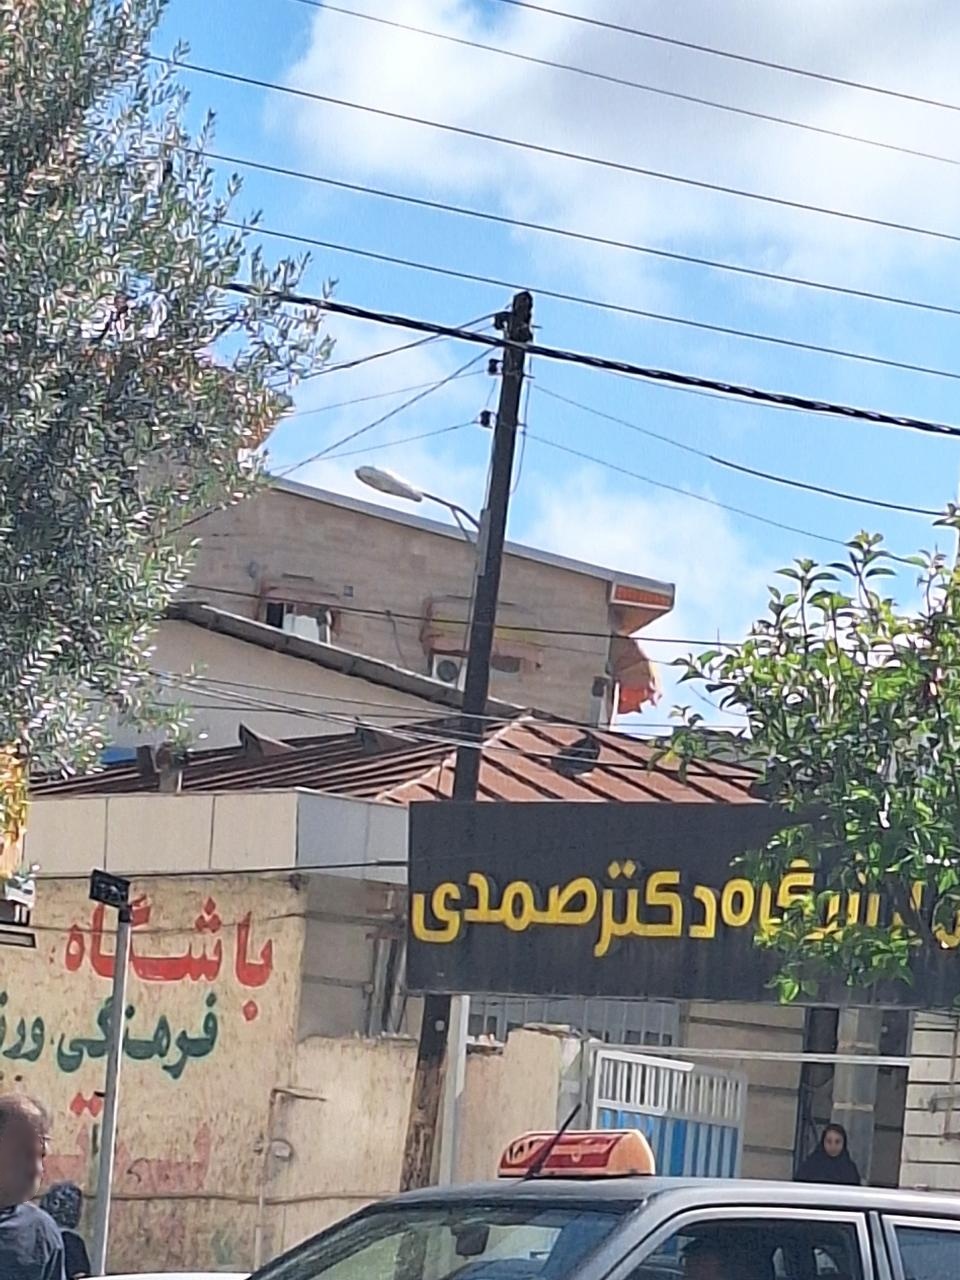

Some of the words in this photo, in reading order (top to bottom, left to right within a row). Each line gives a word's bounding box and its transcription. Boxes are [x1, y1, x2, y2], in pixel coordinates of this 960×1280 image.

[411, 869, 598, 944] صمدی
[594, 860, 715, 958] دکتر
[65, 895, 273, 1022] باشگاه
